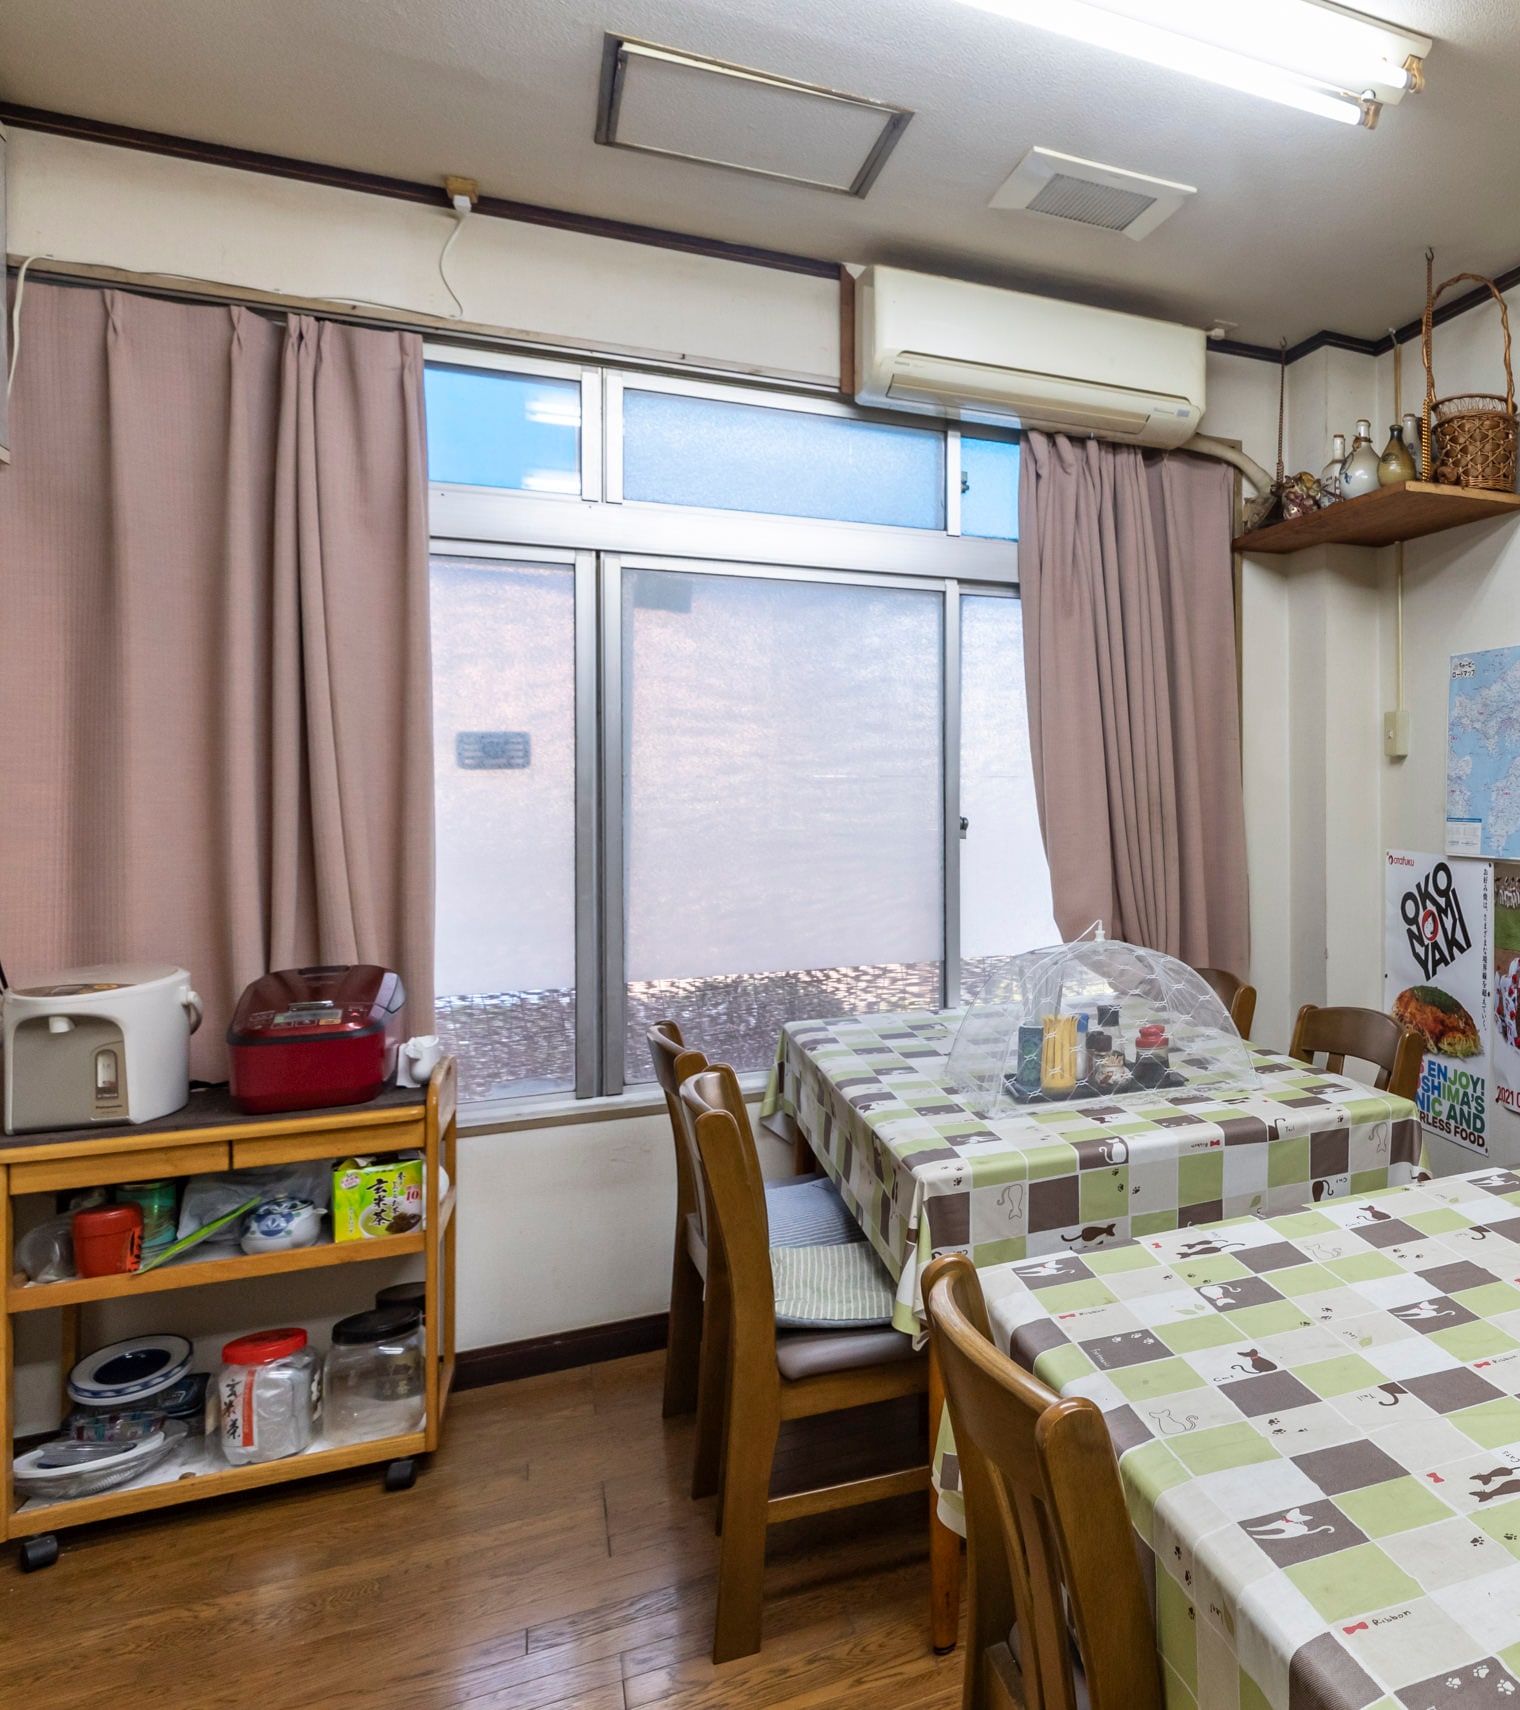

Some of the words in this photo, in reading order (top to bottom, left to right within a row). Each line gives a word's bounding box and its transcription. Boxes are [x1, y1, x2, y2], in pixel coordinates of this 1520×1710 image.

[1427, 1060, 1485, 1097] ENJOY!
[1496, 1085, 1515, 1106] 2021
[1446, 1103, 1486, 1134] AND
[1453, 1125, 1486, 1148] FOOD
[366, 1178, 393, 1226] 玄米茶
[406, 1190, 419, 1201] 10
[223, 1379, 241, 1440] 玄米茶
[1371, 1609, 1412, 1627] Ribbon
